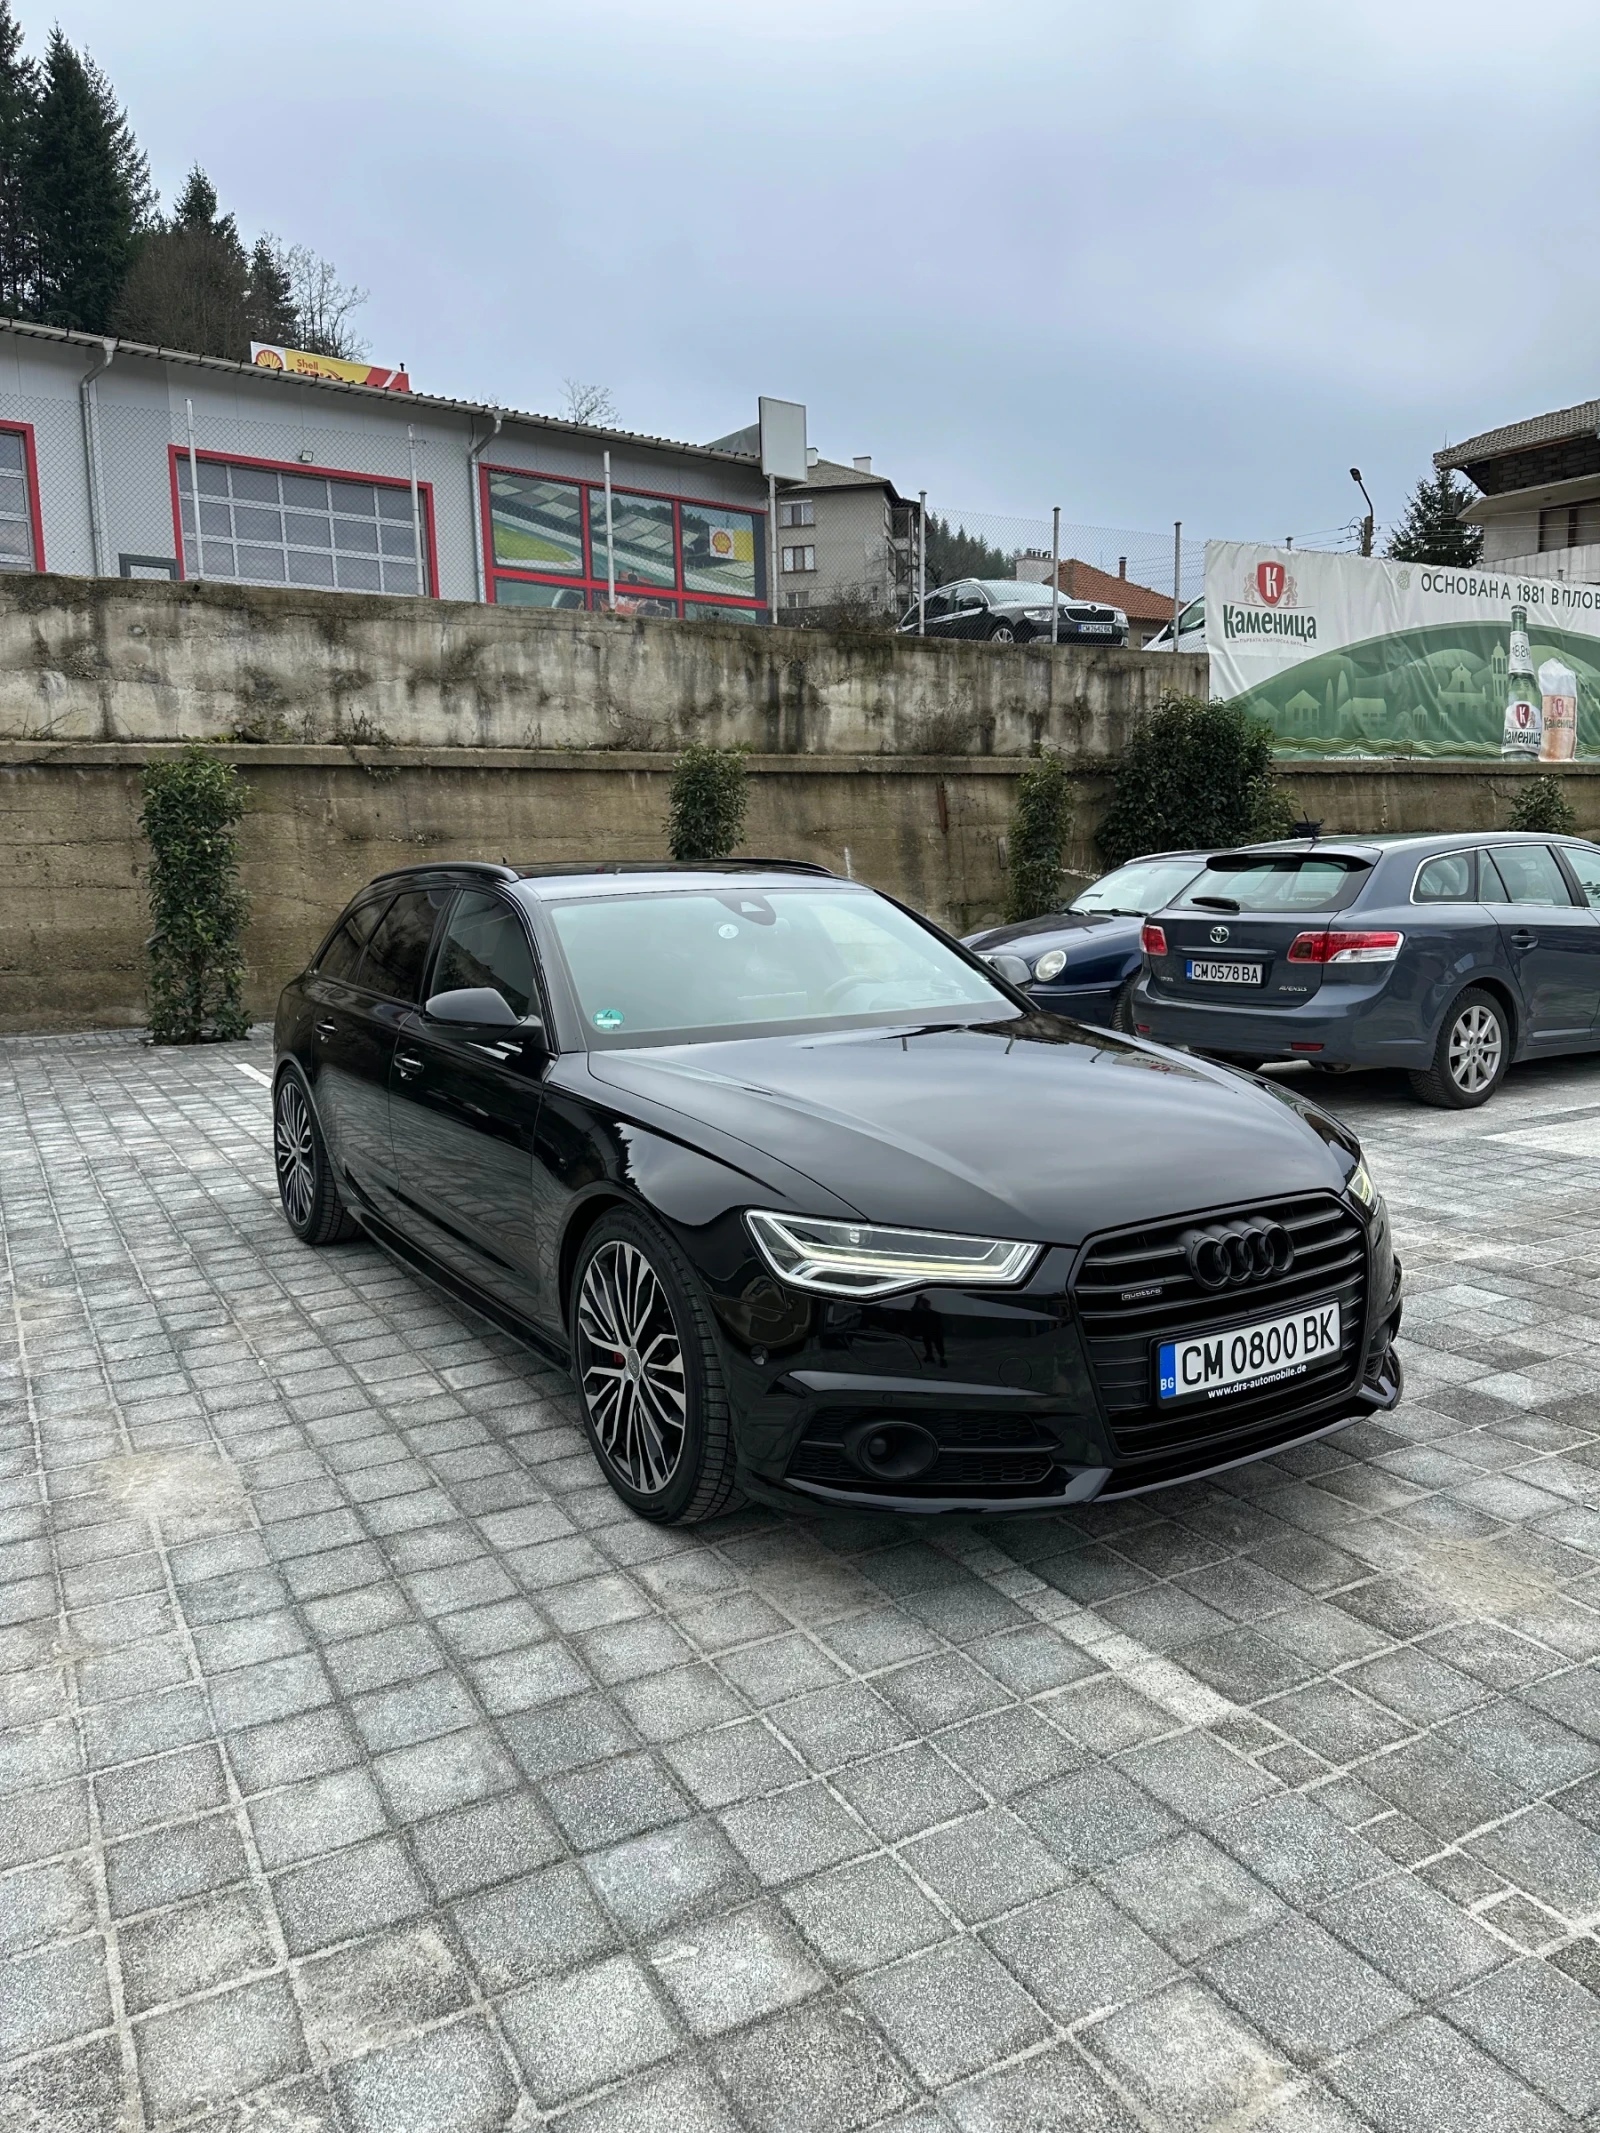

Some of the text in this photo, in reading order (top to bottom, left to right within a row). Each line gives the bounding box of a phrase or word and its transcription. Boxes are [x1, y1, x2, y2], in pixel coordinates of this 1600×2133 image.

[296, 358, 319, 371] Shell
[1421, 572, 1511, 601] ОСНОВАНА
[1516, 583, 1545, 604] 1881
[1551, 587, 1559, 606] В
[1222, 604, 1317, 643] Каменица
[1193, 963, 1259, 982] CM 0578 BA
[604, 1010, 613, 1019] 4
[1123, 1287, 1161, 1300] quattro
[1181, 1308, 1335, 1386] CM 0800 BK
[1160, 1376, 1175, 1391] BG
[1207, 1363, 1307, 1399] www.drs-automobile.de
